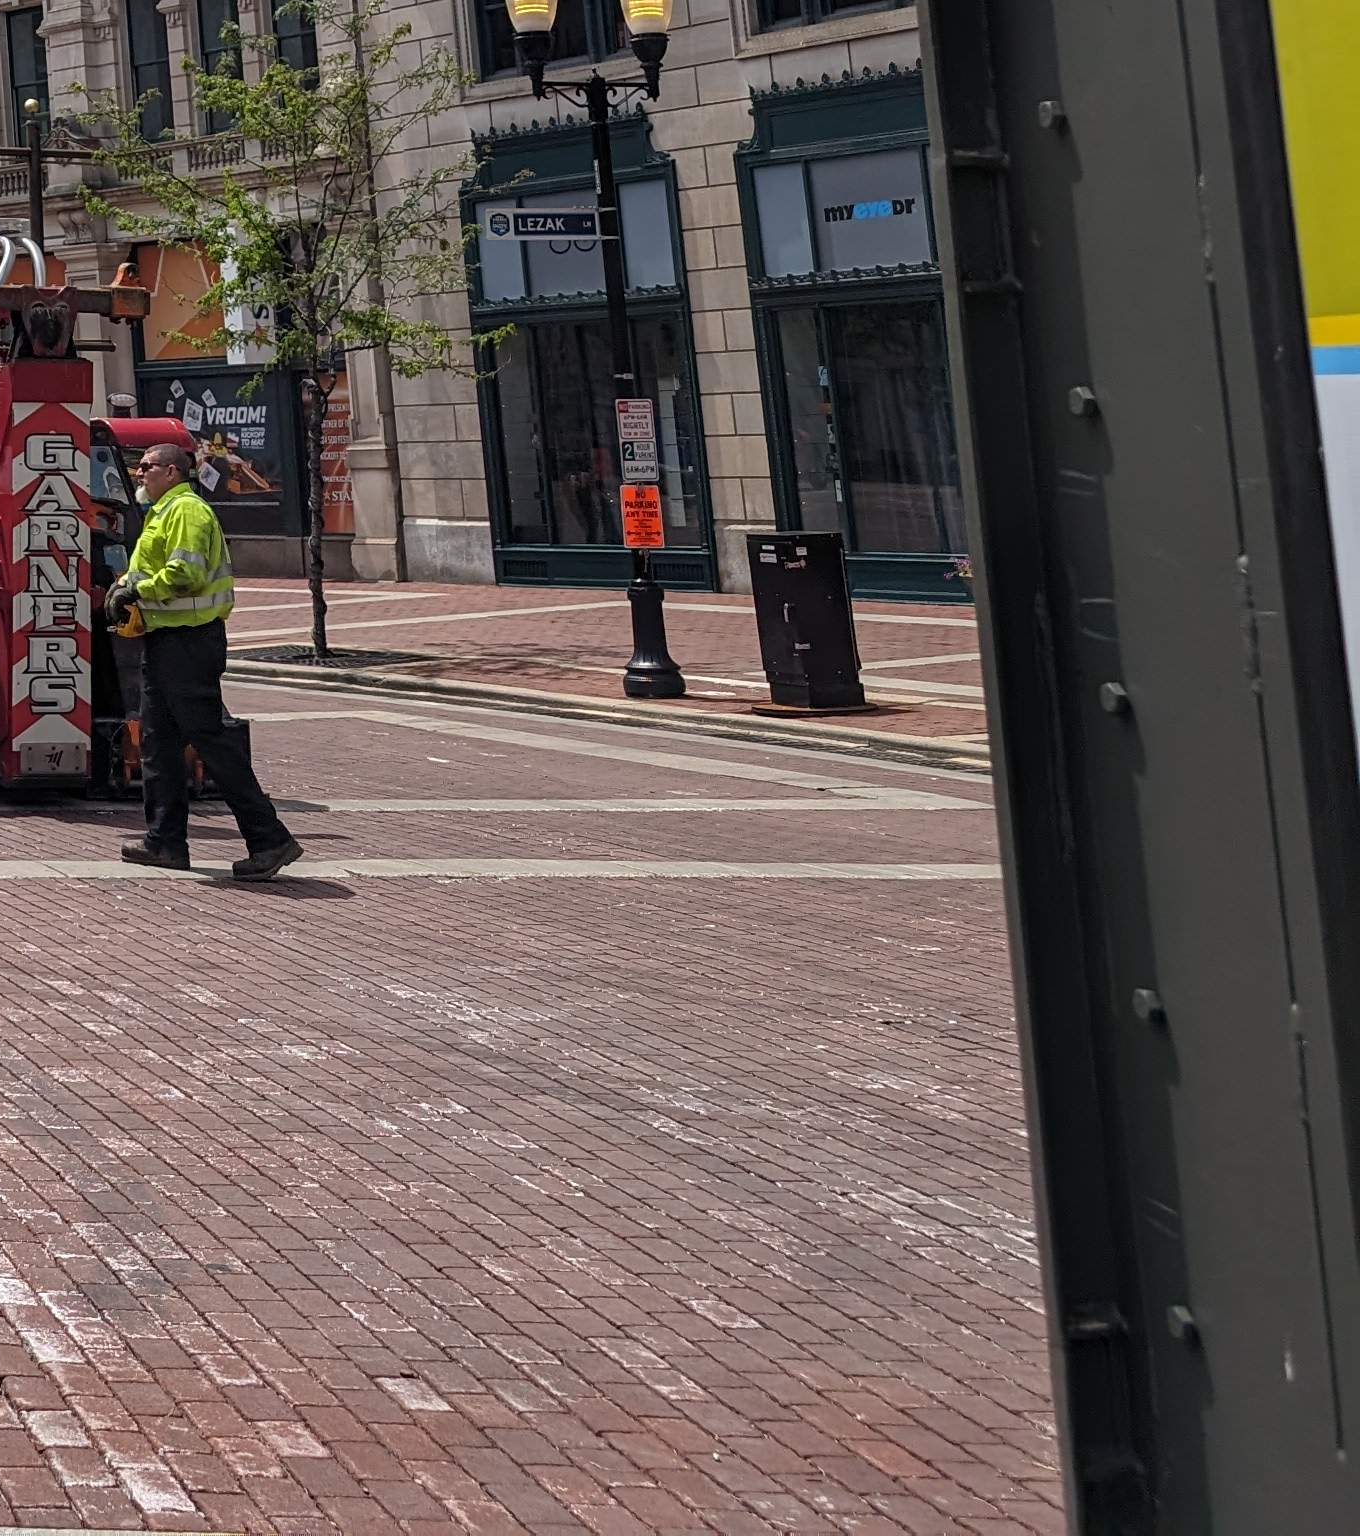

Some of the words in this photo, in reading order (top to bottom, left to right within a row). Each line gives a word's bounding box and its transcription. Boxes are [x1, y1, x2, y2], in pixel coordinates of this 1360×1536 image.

[518, 217, 566, 232] LEZAK
[582, 220, 592, 228] LN
[205, 405, 267, 426] VROOM!
[622, 421, 649, 430] NIGHTLY
[240, 431, 265, 439] KICKOFF
[241, 439, 250, 447] TO
[250, 438, 266, 446] MAY
[624, 443, 634, 459] 2
[624, 500, 658, 509] PARKING
[625, 510, 640, 518] ANY
[641, 510, 659, 518] TIME
[23, 432, 87, 714] GARNERS
